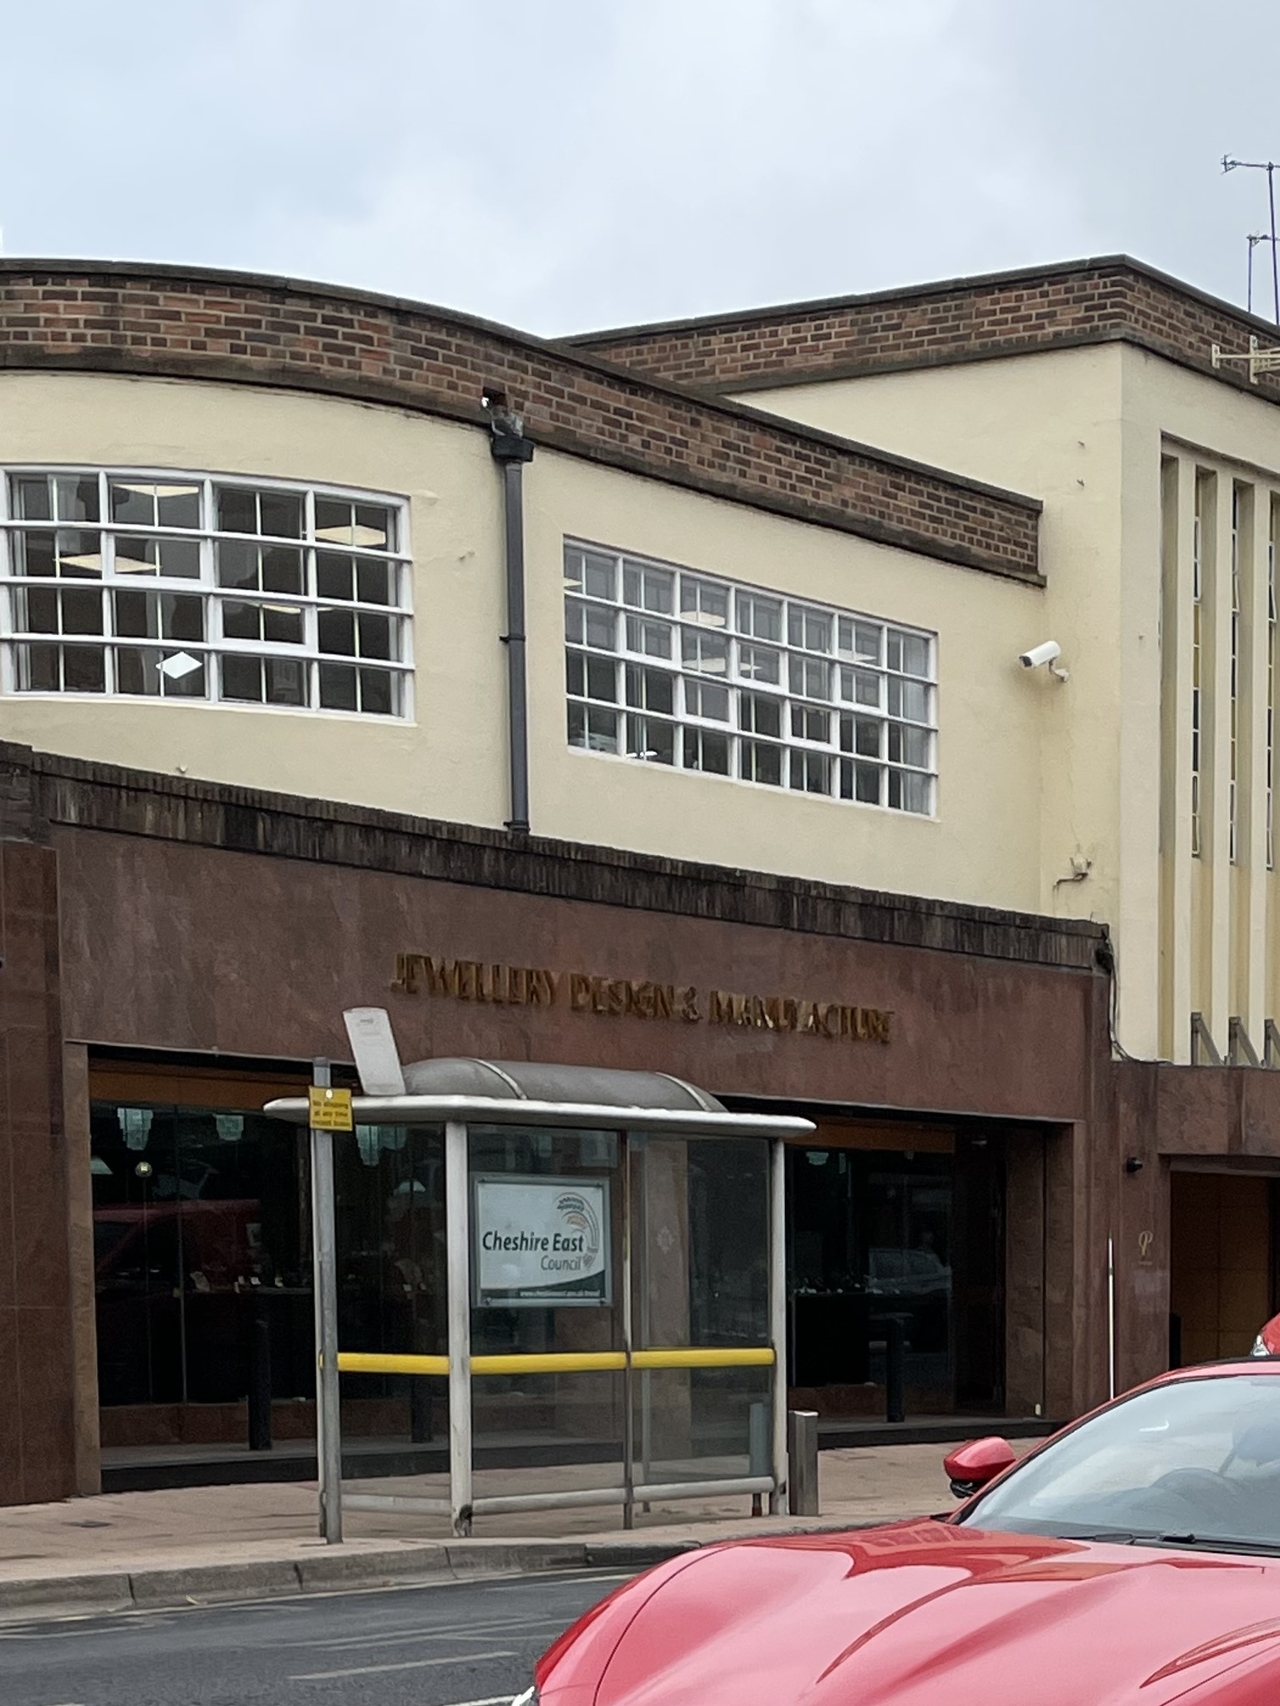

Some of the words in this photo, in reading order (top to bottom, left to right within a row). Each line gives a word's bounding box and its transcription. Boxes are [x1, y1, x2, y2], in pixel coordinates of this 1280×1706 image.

[567, 973, 675, 1020] DESIGN
[678, 985, 703, 1024] &
[709, 990, 894, 1044] MANUFACTURE
[482, 1230, 549, 1252] Cheshire
[553, 1233, 584, 1252] East
[541, 1254, 581, 1270] Council
